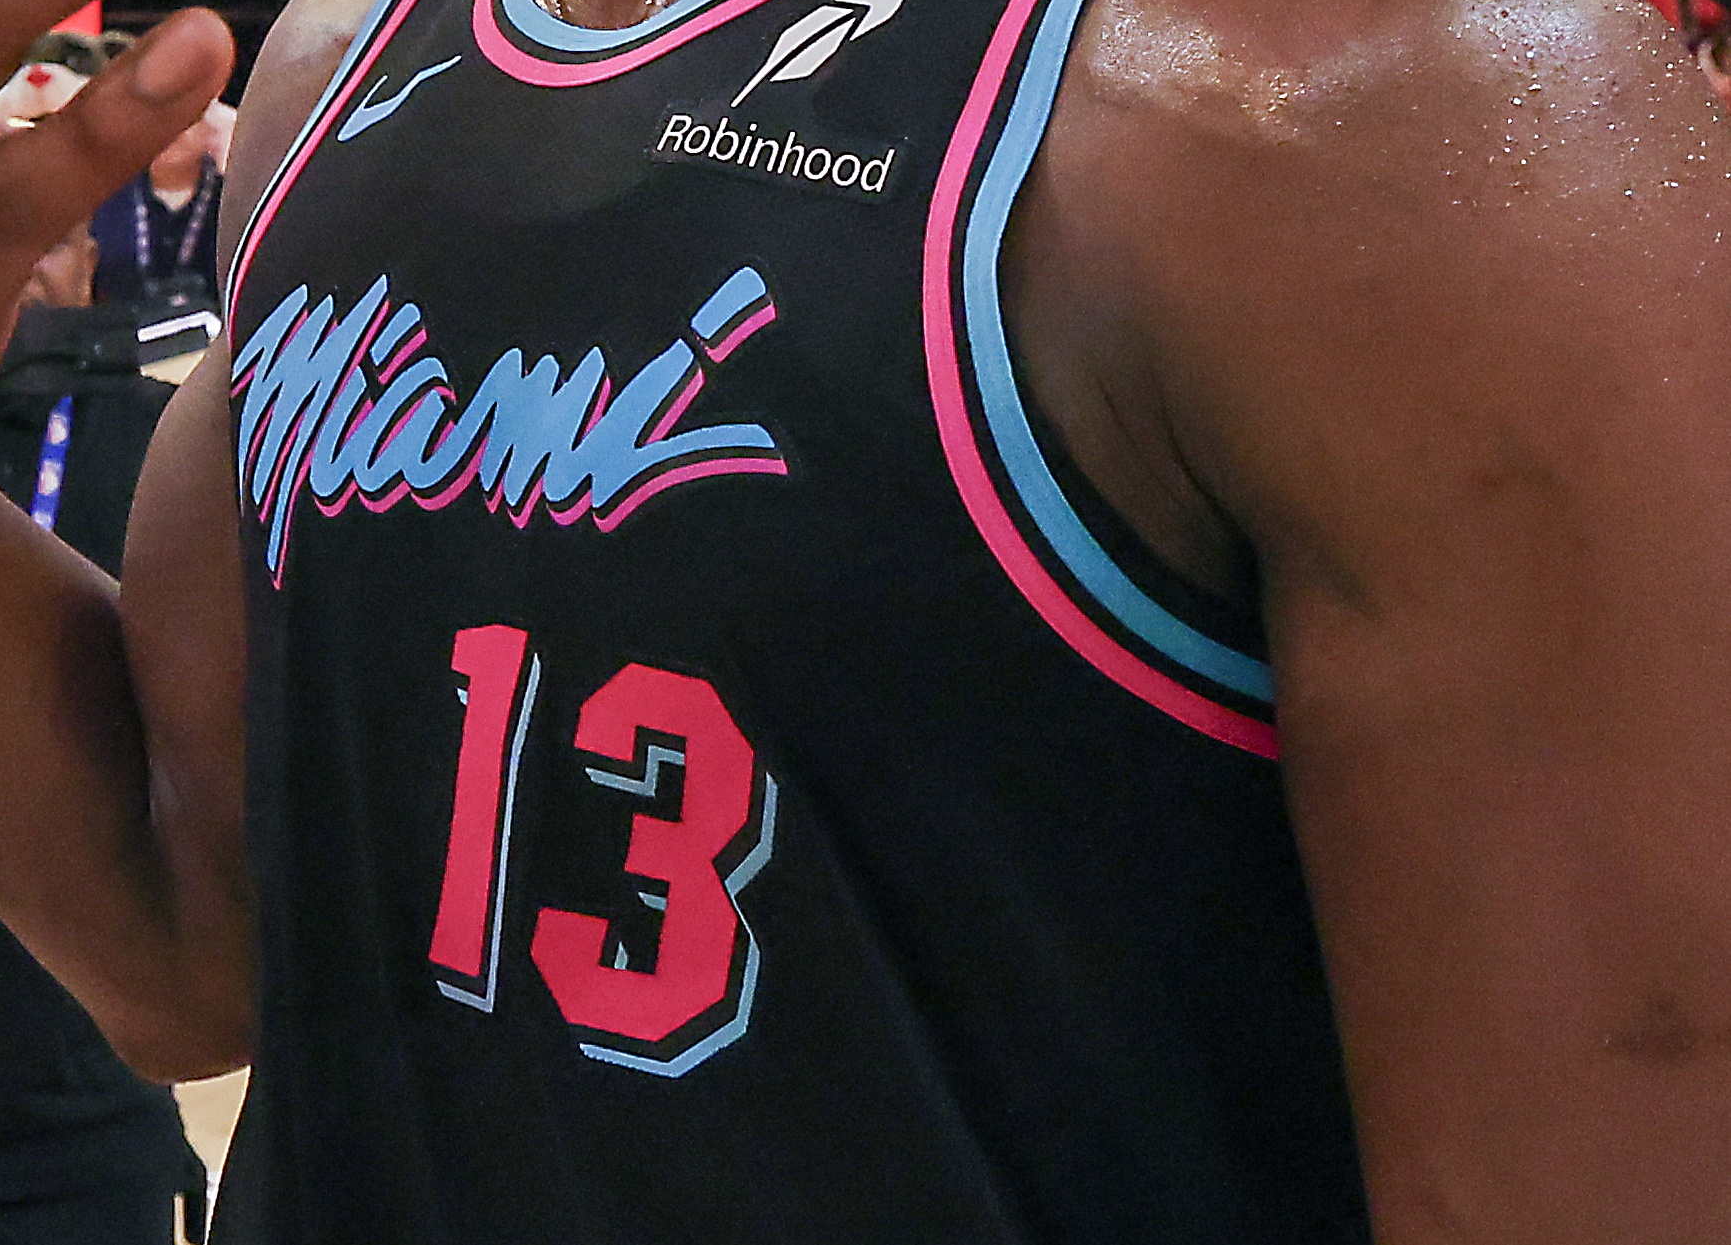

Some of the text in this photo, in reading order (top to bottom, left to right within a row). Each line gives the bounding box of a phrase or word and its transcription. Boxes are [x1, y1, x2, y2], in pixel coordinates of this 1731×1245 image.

[655, 112, 896, 195] Robinhood
[231, 265, 789, 590] Miami
[428, 623, 779, 1079] 13
